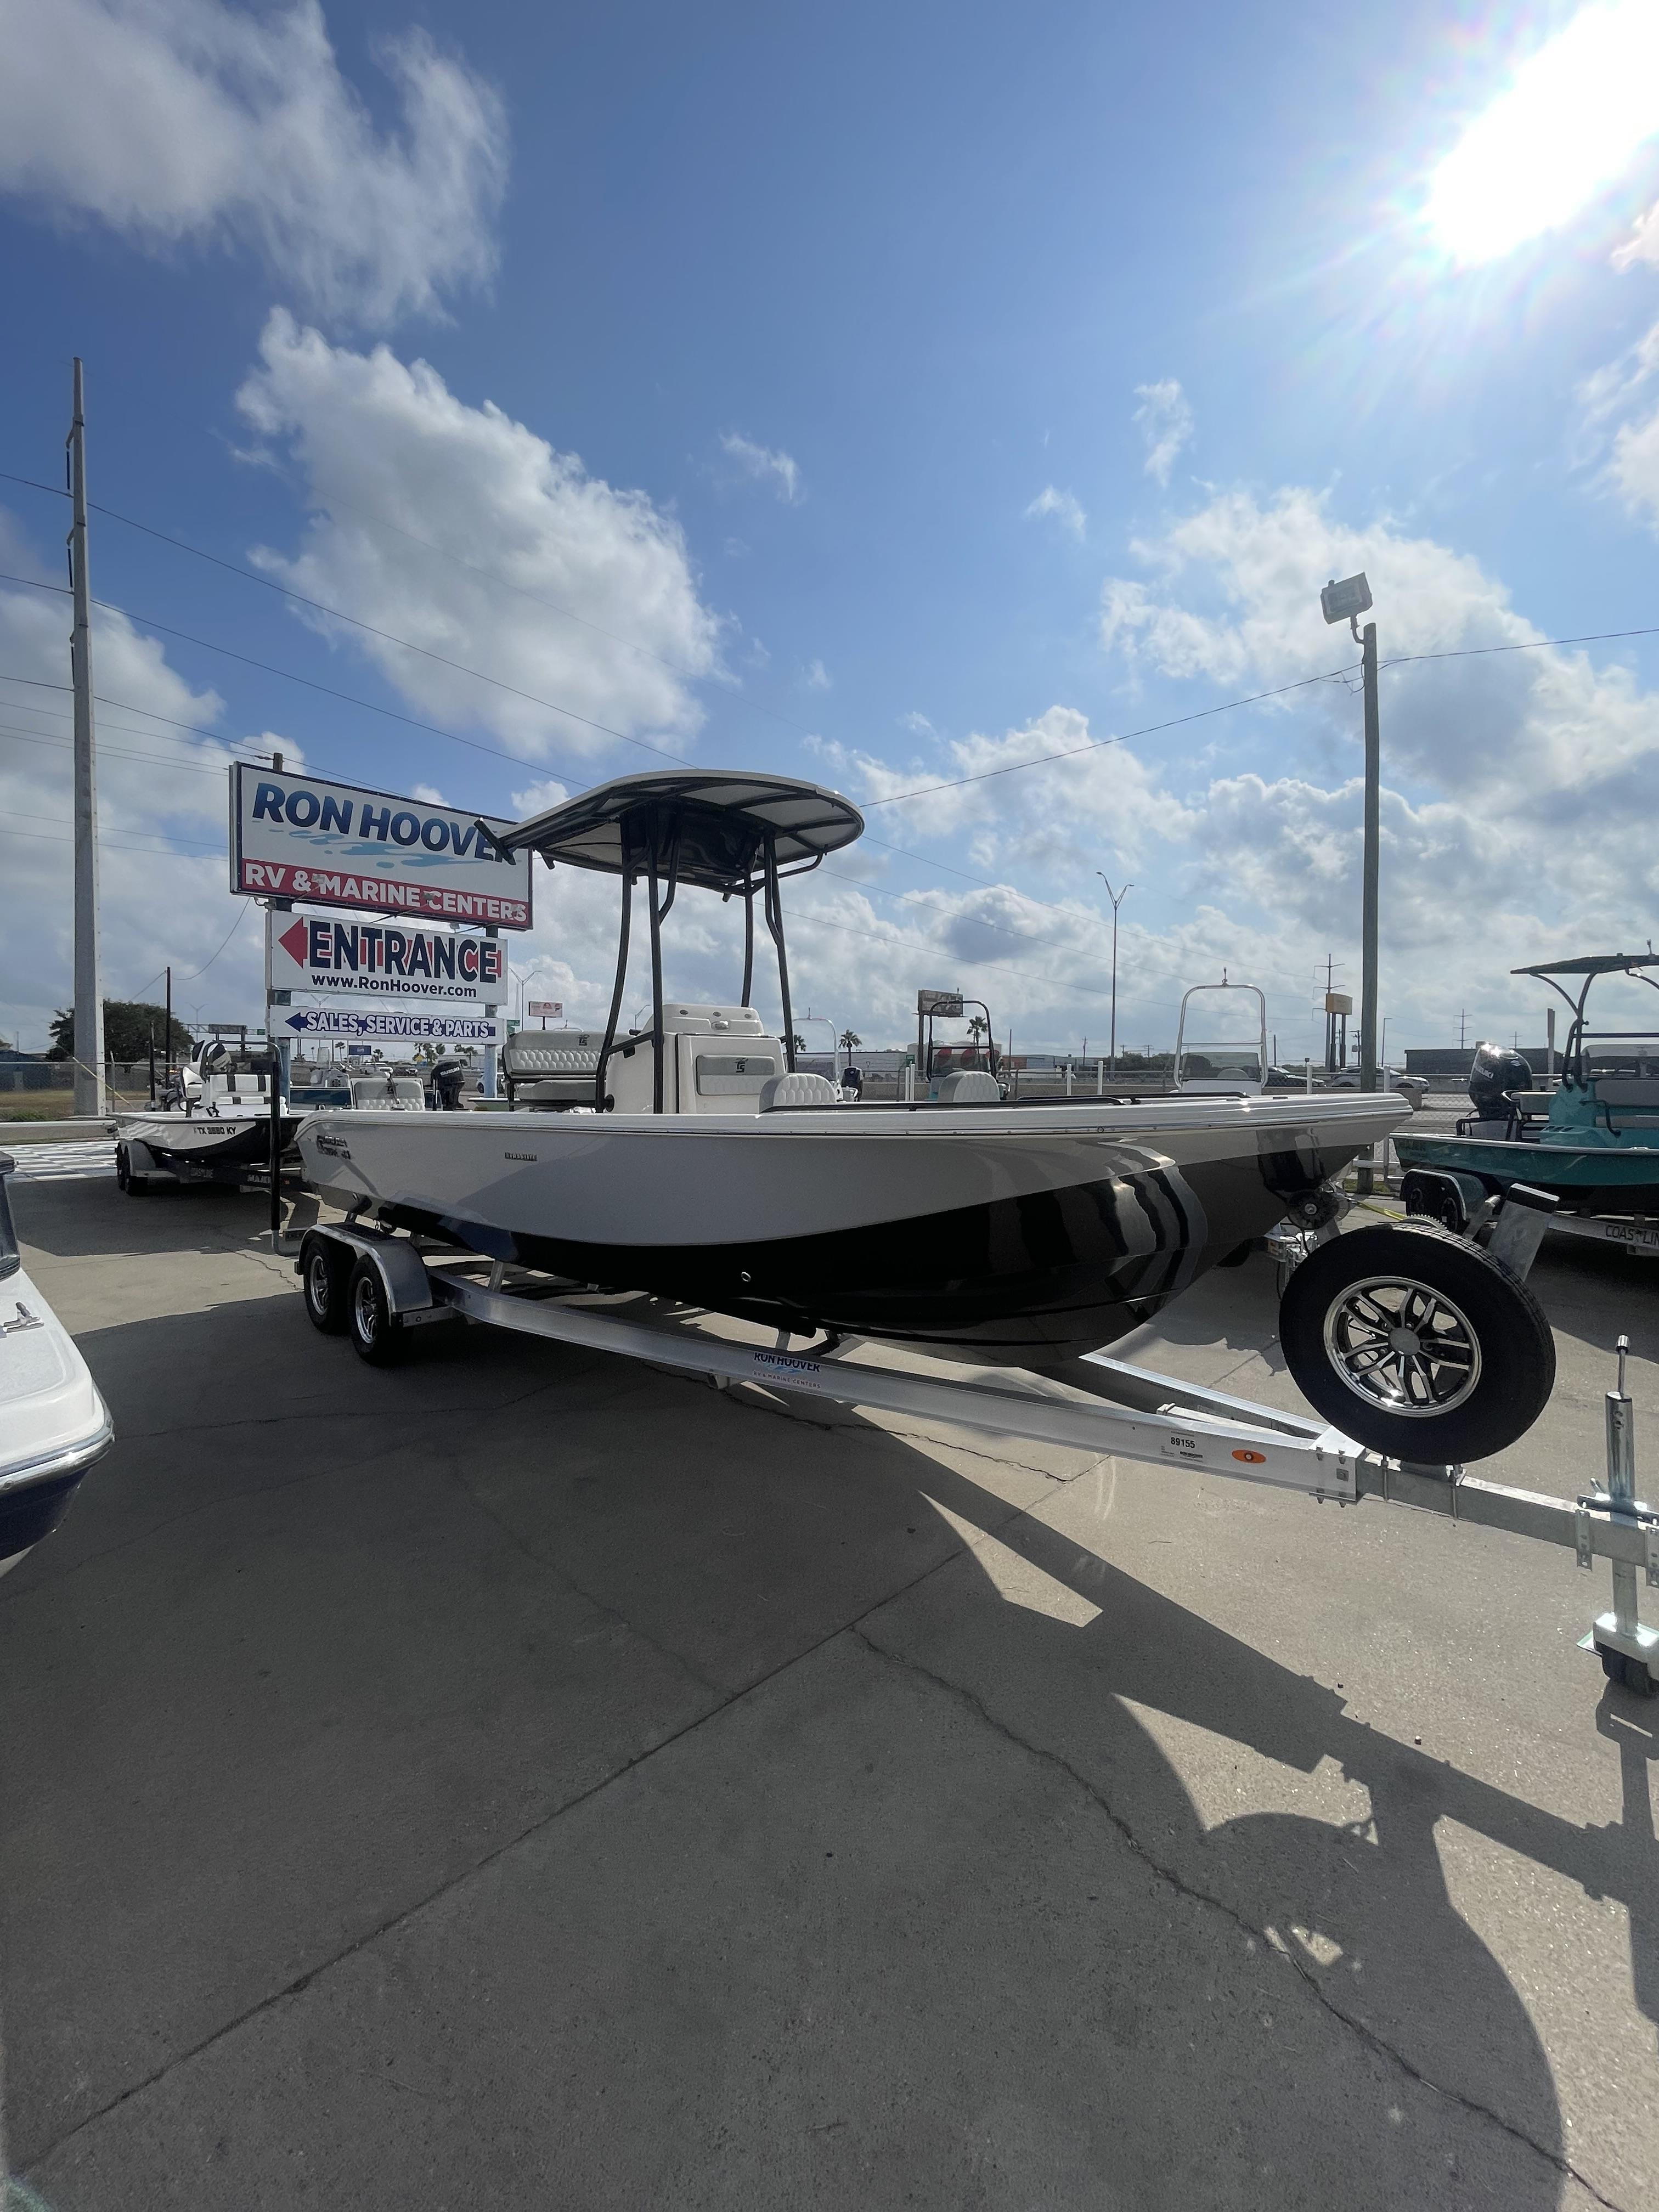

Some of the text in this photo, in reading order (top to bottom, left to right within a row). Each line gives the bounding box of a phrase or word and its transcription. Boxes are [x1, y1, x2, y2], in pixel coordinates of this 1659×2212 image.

[252, 782, 353, 839] RON
[246, 862, 527, 922] RV & MARINE CENTERS
[309, 921, 496, 983] ENTRANCE
[312, 975, 477, 997] www.RonHoover.com
[306, 1012, 489, 1038] SALES, SERVICE & PARTS
[754, 1352, 820, 1372] RON HOOVER
[768, 1374, 790, 1382] MARINE
[793, 1378, 821, 1389] CENTERS
[1171, 1437, 1195, 1448] 89155
